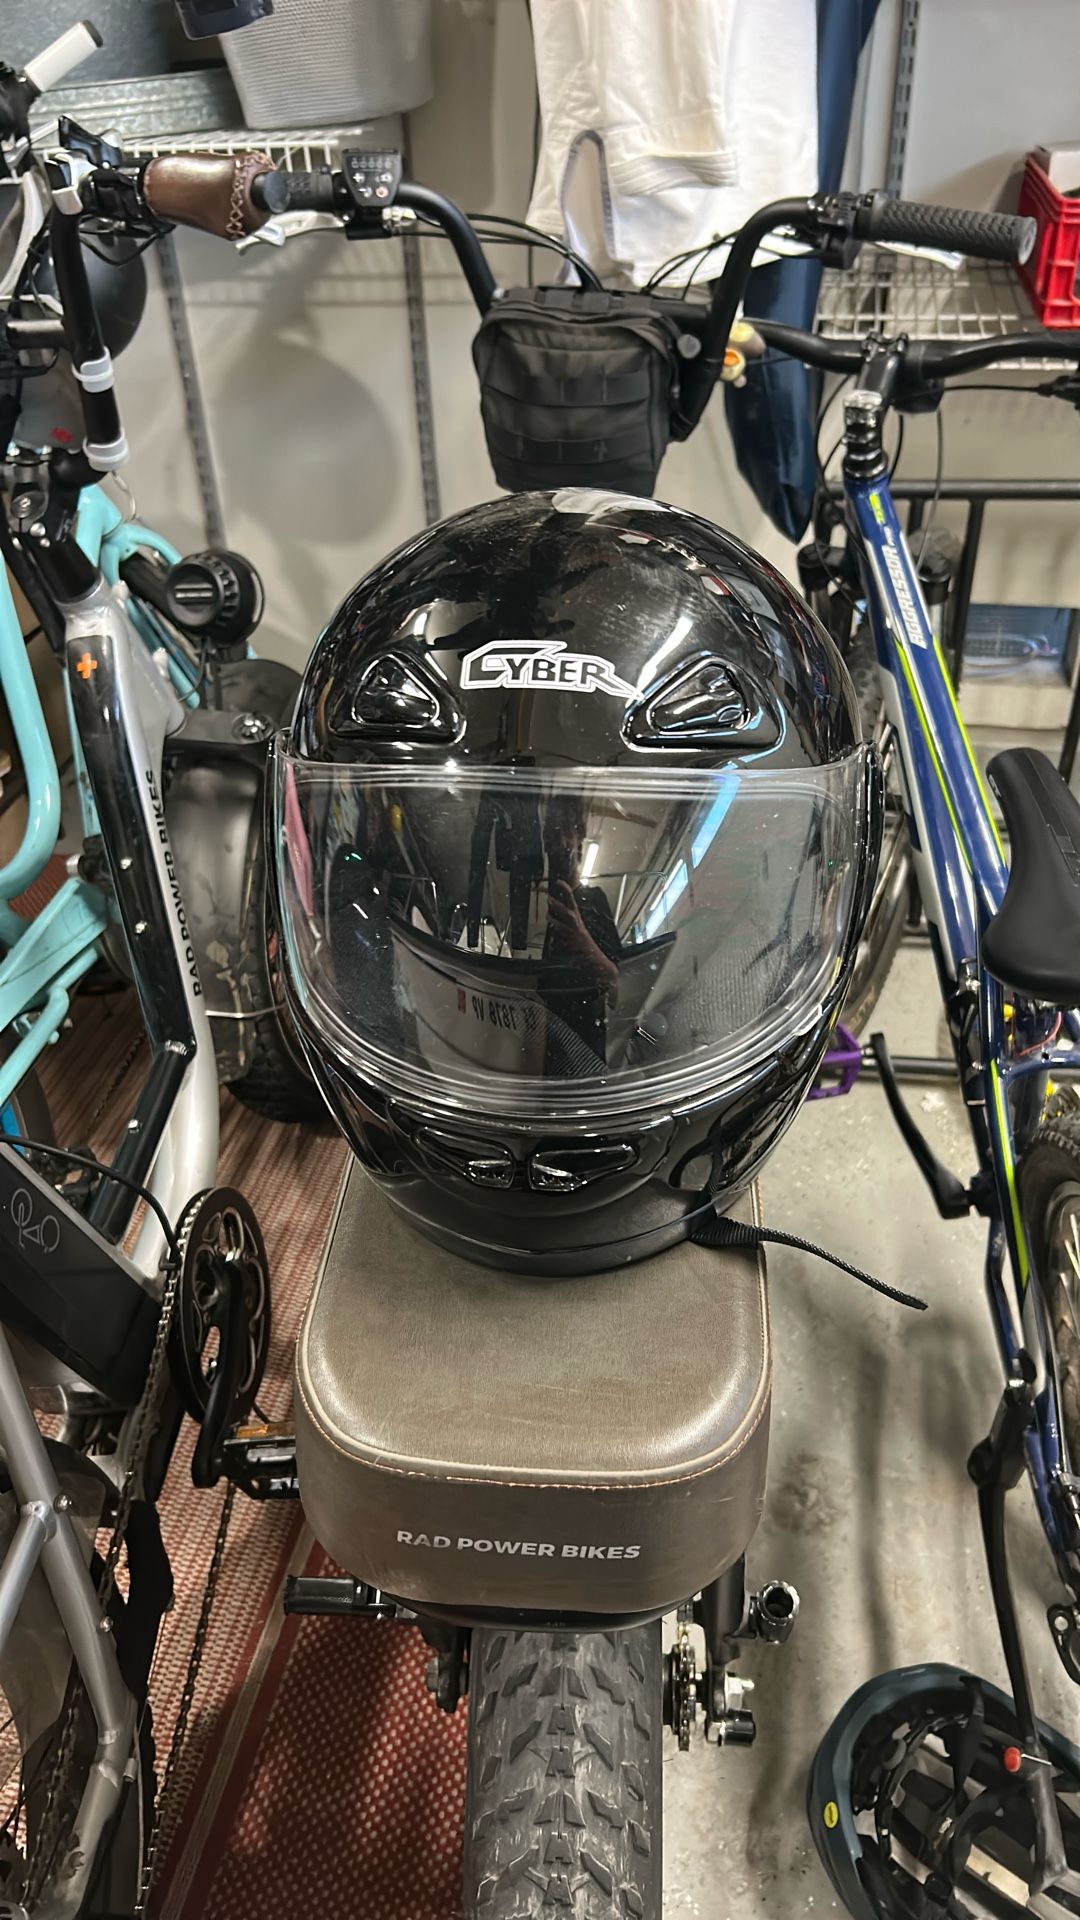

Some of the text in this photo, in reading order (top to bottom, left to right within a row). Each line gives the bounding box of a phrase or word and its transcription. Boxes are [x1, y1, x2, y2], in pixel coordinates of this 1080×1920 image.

[882, 545, 928, 650] AGGRESSOR
[460, 640, 638, 698] CYBER
[145, 769, 169, 844] BIKES
[164, 851, 190, 941] POWER
[397, 1530, 642, 1560] RAD POWER BIKES
